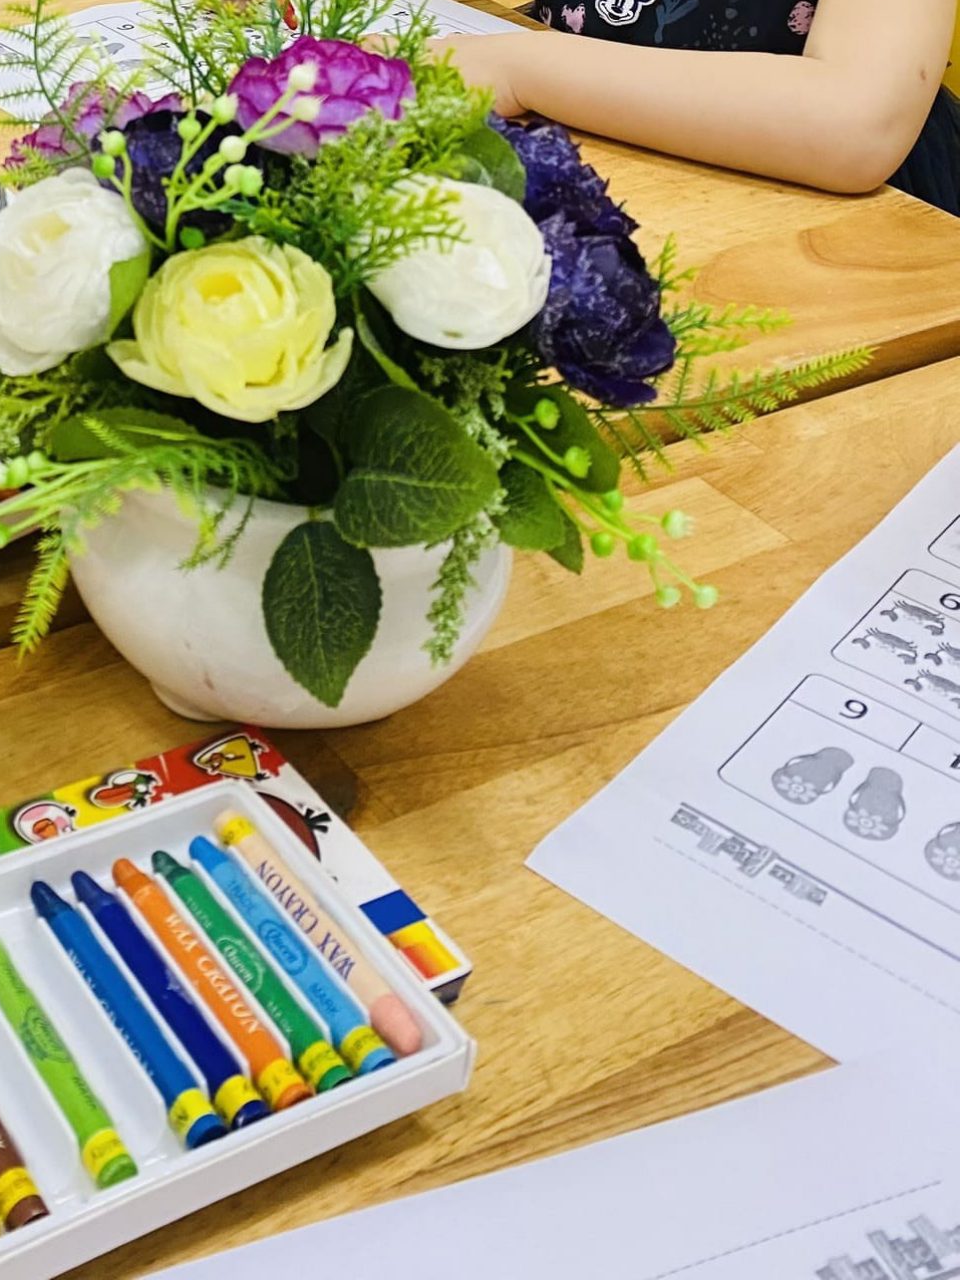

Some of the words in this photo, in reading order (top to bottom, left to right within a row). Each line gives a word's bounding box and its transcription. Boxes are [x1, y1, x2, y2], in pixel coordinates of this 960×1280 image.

[256, 859, 319, 936] CRAYON
[165, 913, 200, 953] WAX
[316, 931, 357, 982] WAX
